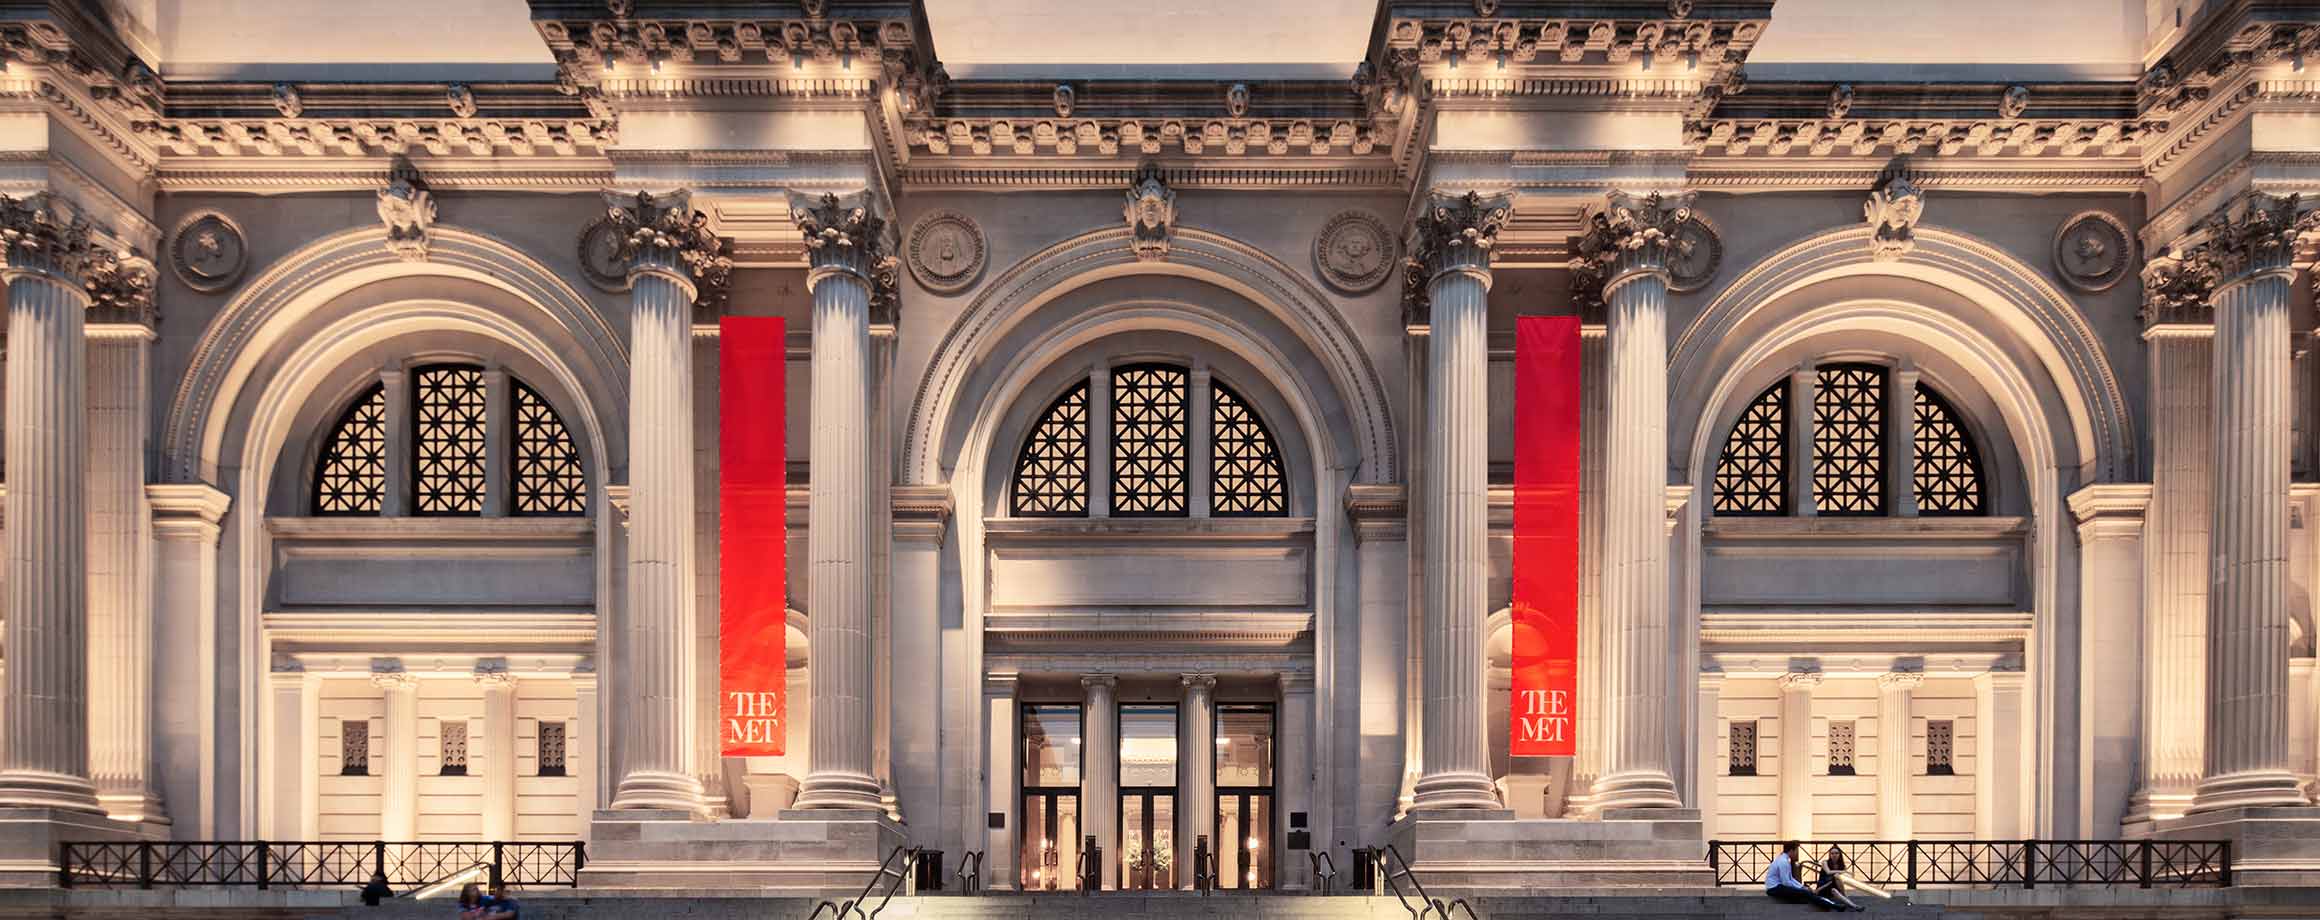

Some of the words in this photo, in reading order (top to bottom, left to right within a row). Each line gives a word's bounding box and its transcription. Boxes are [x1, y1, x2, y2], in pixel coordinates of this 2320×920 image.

[729, 691, 776, 717] THE
[1520, 690, 1567, 715] THE
[728, 718, 778, 744] MET
[1519, 717, 1569, 742] MET
